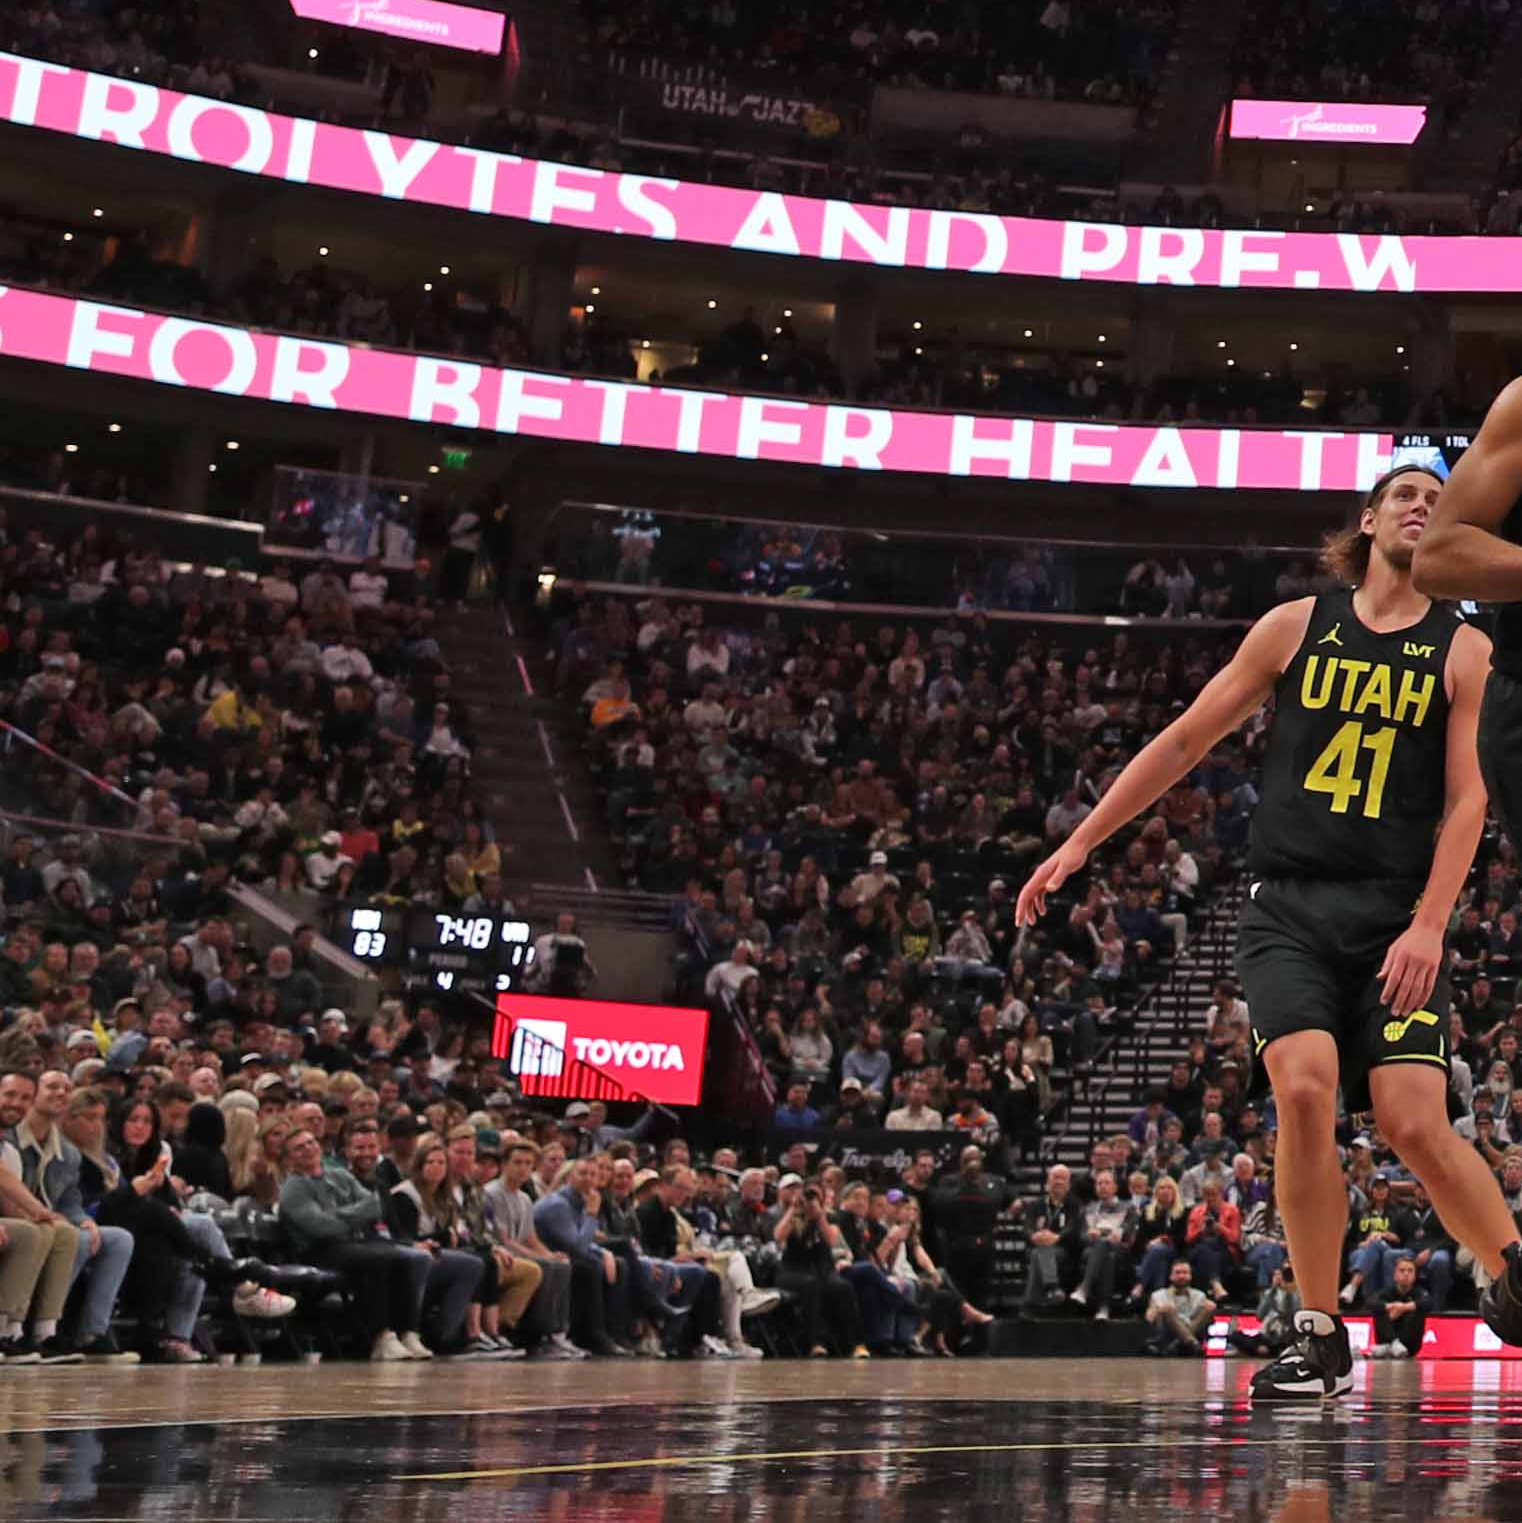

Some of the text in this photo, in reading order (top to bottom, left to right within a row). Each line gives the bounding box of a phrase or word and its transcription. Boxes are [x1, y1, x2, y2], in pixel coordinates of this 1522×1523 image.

[731, 190, 1009, 274] AND
[65, 299, 351, 409] FOR
[408, 356, 895, 472] BETTER
[1411, 435, 1431, 448] FLS
[1402, 641, 1436, 659] LVT
[1301, 654, 1437, 727] UTAH
[1303, 720, 1398, 819] 41
[353, 930, 386, 958] 83
[435, 913, 494, 950] 7:48
[572, 1037, 685, 1071] TOYOTA
